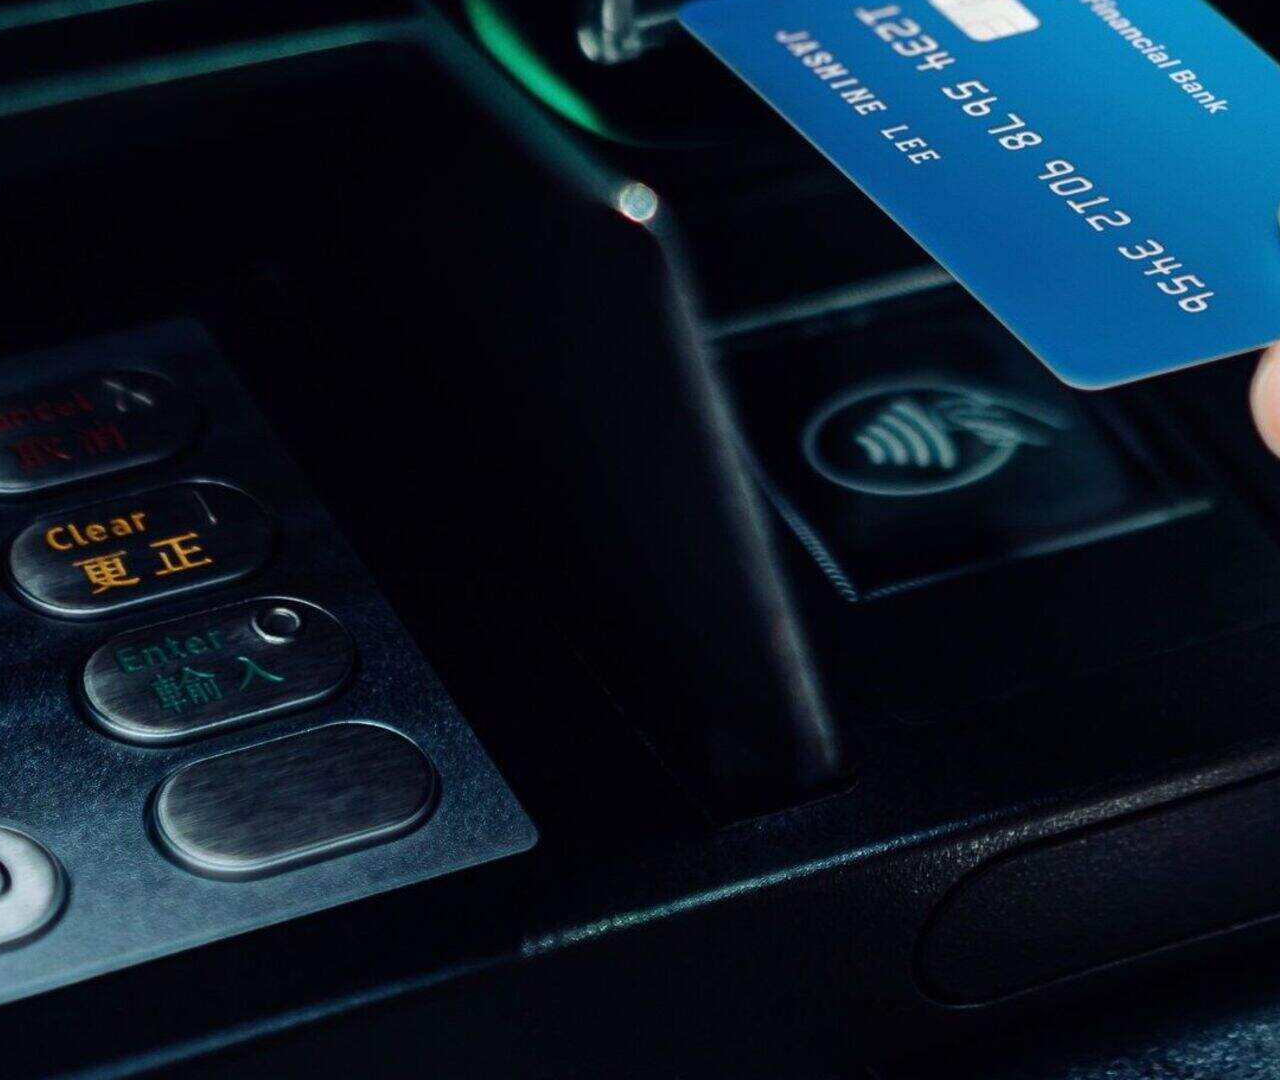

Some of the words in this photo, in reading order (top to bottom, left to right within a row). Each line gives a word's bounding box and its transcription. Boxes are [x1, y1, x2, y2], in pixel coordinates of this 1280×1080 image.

[775, 30, 887, 116] JASMINE
[881, 124, 941, 164] LEE
[1169, 69, 1228, 114] Bank
[854, 4, 956, 71] 1234
[942, 80, 1042, 150] 5678
[1038, 159, 1131, 231] 9012
[1118, 239, 1214, 312] 3456
[44, 509, 147, 551] Clear
[72, 531, 214, 595] 更正
[115, 627, 223, 673] Enter
